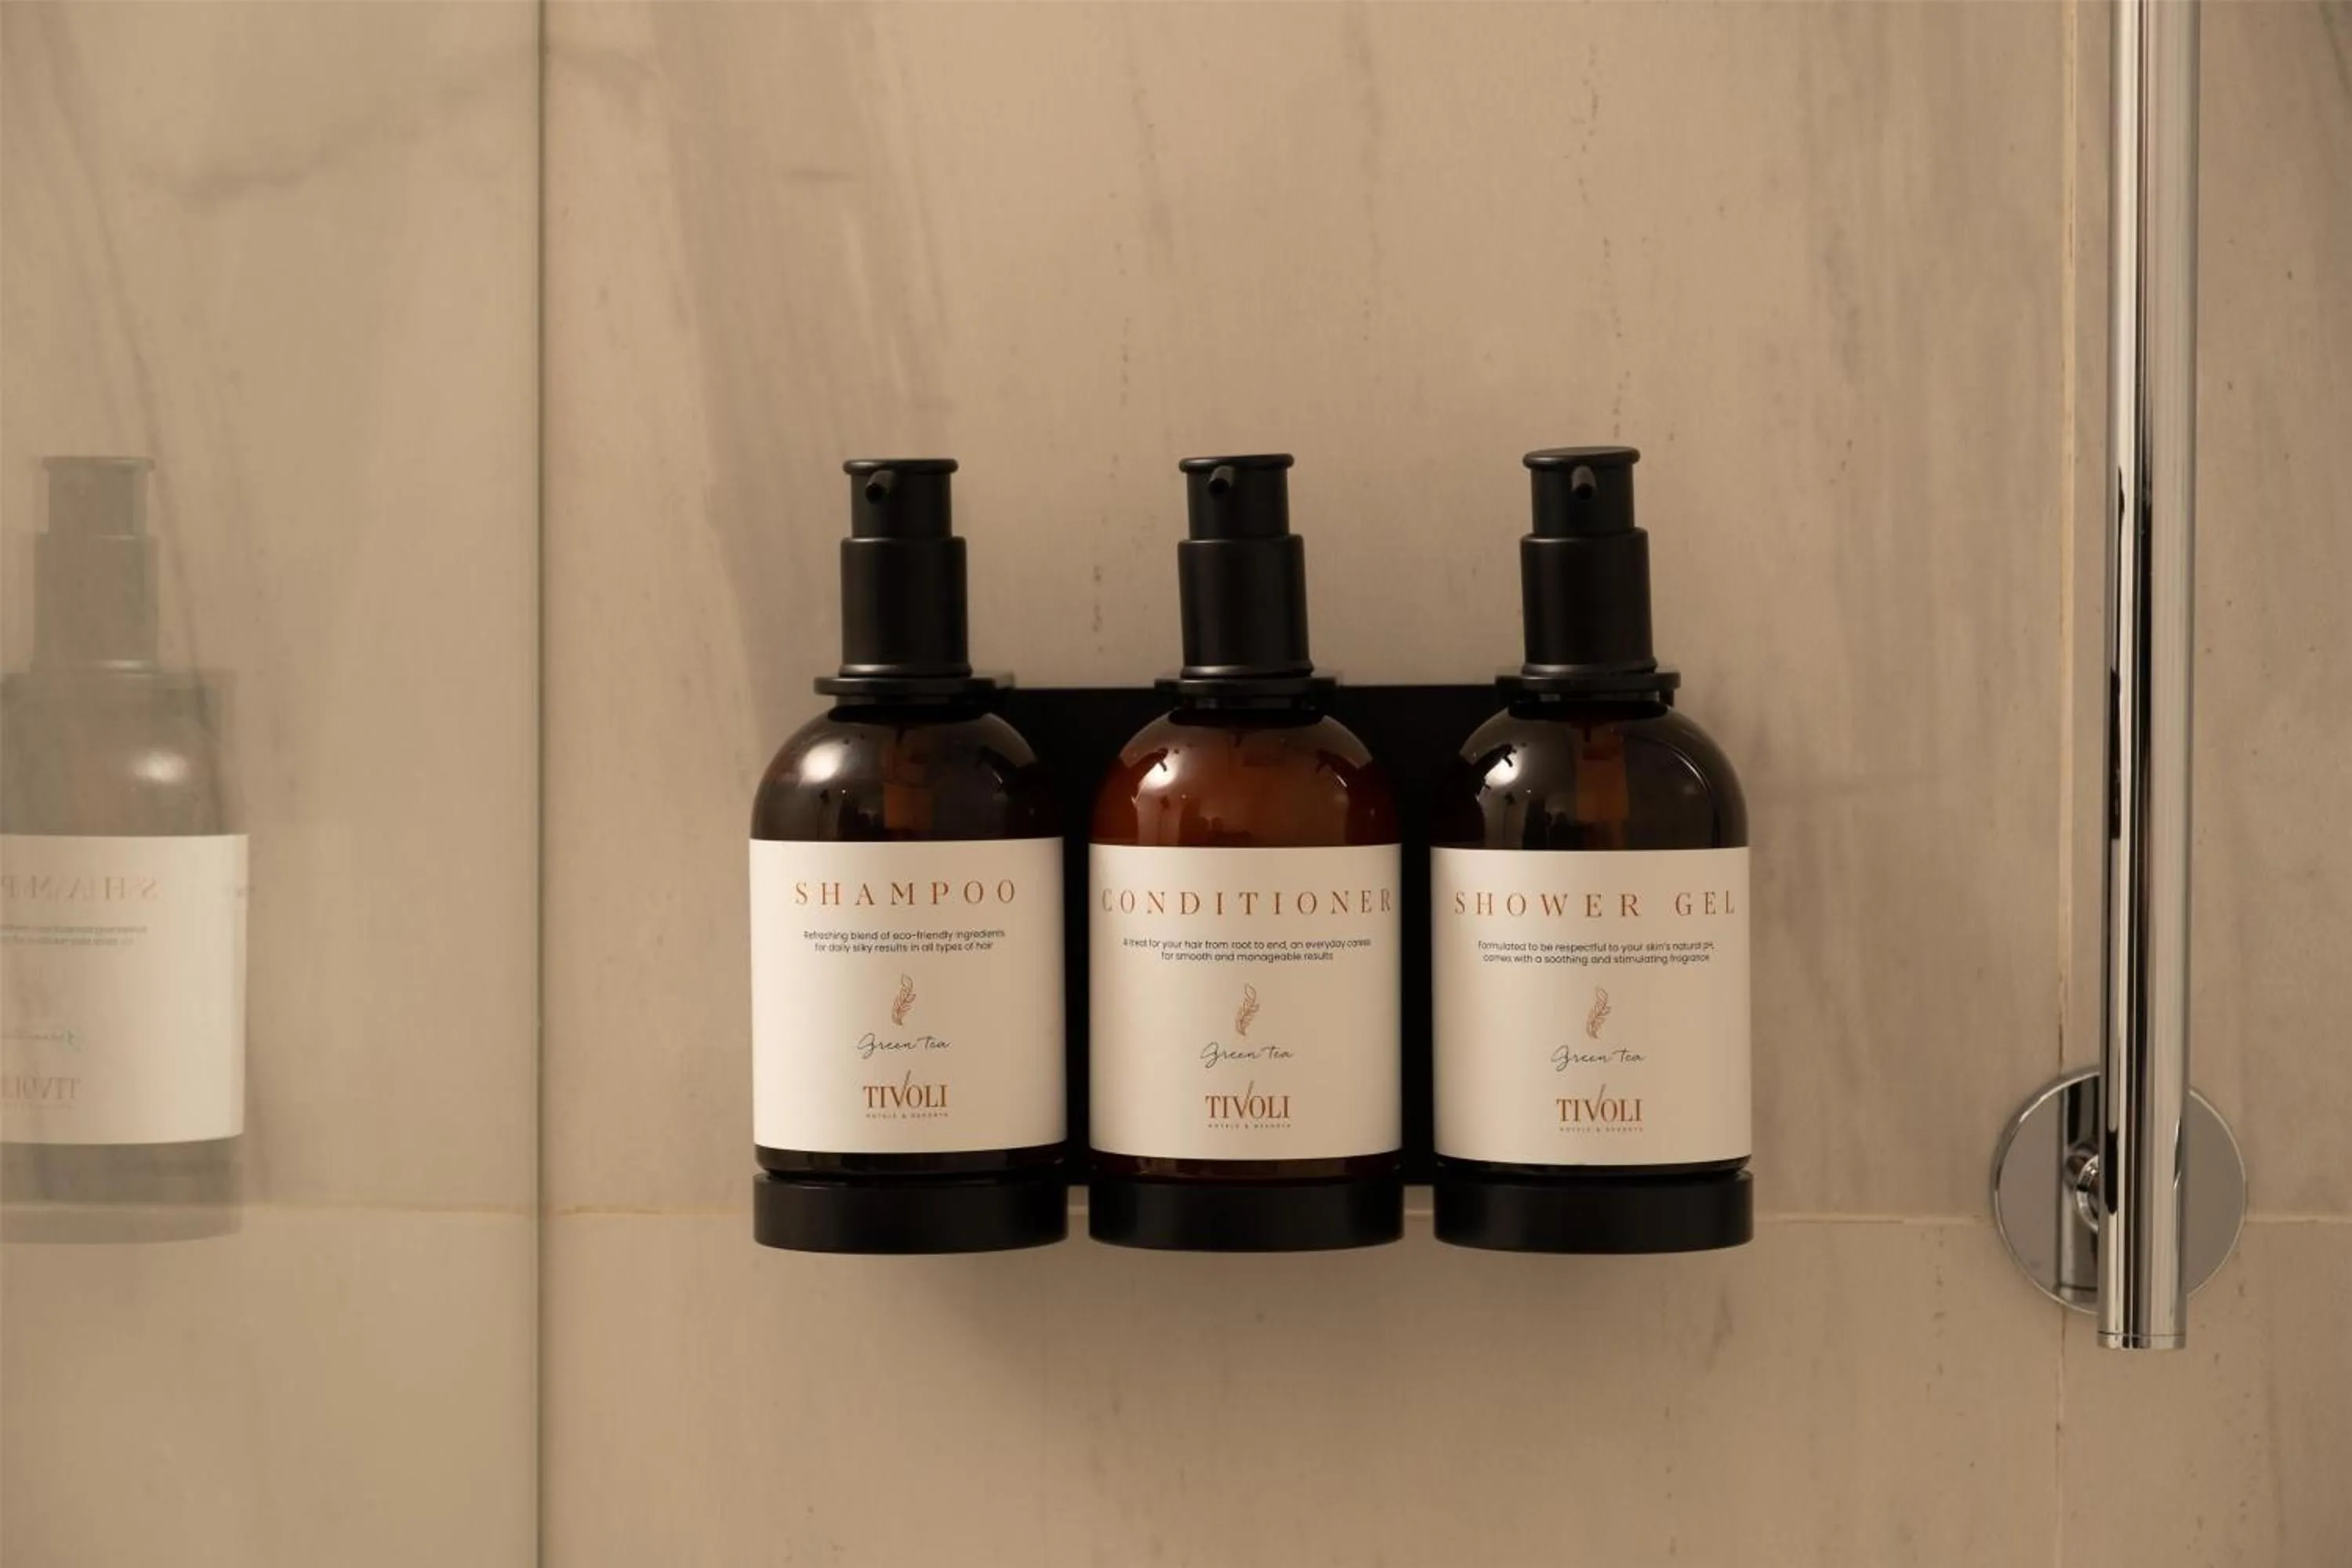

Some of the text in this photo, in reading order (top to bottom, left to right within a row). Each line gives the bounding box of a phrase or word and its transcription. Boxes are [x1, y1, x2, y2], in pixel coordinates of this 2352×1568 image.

[795, 879, 1015, 906] SHAMPOO
[1102, 888, 1392, 916] CONDITIONER
[1454, 890, 1735, 918] SHOWER GEL
[851, 931, 878, 940] blend
[880, 931, 890, 940] of
[893, 930, 953, 942] eco-friendly
[852, 943, 873, 953] silky
[874, 943, 908, 953] results
[910, 942, 920, 951] in
[921, 942, 934, 951] all
[936, 942, 963, 953] types
[964, 942, 974, 951] of
[1149, 939, 1160, 948] for
[1162, 940, 1182, 950] your
[1185, 940, 1203, 949] hair
[1205, 940, 1229, 949] from
[1231, 941, 1252, 949] root
[1254, 941, 1265, 949] to
[1267, 941, 1287, 950] end,
[1305, 939, 1345, 950] everyday
[1479, 941, 1526, 951] Formulated
[1528, 942, 1537, 951] to
[1555, 942, 1606, 953] respectful
[1621, 944, 1643, 953] your
[1161, 951, 1334, 964] for smooth and manageable results
[1513, 953, 1534, 964] with
[1544, 954, 1588, 967] soothing
[1590, 954, 1611, 964] and
[1613, 954, 1668, 966] stimulating
[857, 1033, 952, 1060] Green Tea
[1200, 1041, 1294, 1069] Green Tea
[1551, 1044, 1646, 1073] Green Tea
[862, 1069, 948, 1109] TIVOLI
[1204, 1080, 1290, 1119] TIVOLI
[1555, 1084, 1642, 1122] TIVOLI
